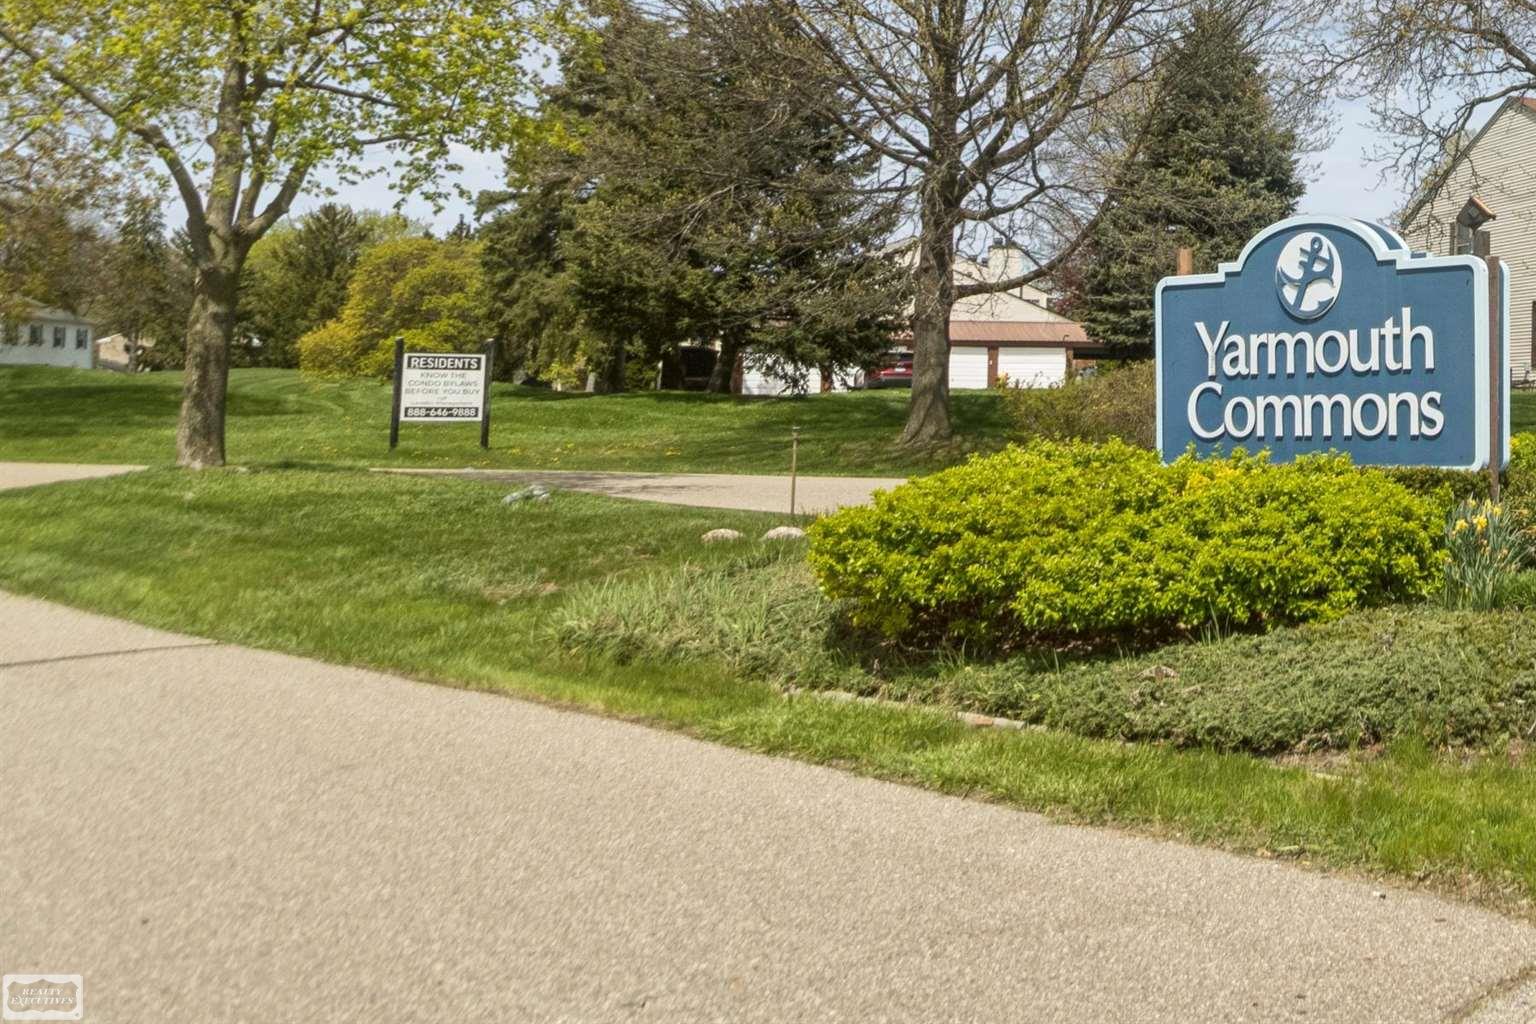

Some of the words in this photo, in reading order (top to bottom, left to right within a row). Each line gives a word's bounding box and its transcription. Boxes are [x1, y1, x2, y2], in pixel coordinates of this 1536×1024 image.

[1195, 307, 1434, 377] Yarmouth
[410, 357, 478, 369] RESIDENTS
[408, 379, 441, 387] CONDO
[443, 379, 479, 387] BYLAWS
[405, 387, 440, 395] BEFORE
[442, 387, 461, 395] YOU
[462, 387, 480, 395] BUY
[1188, 381, 1445, 439] Commons
